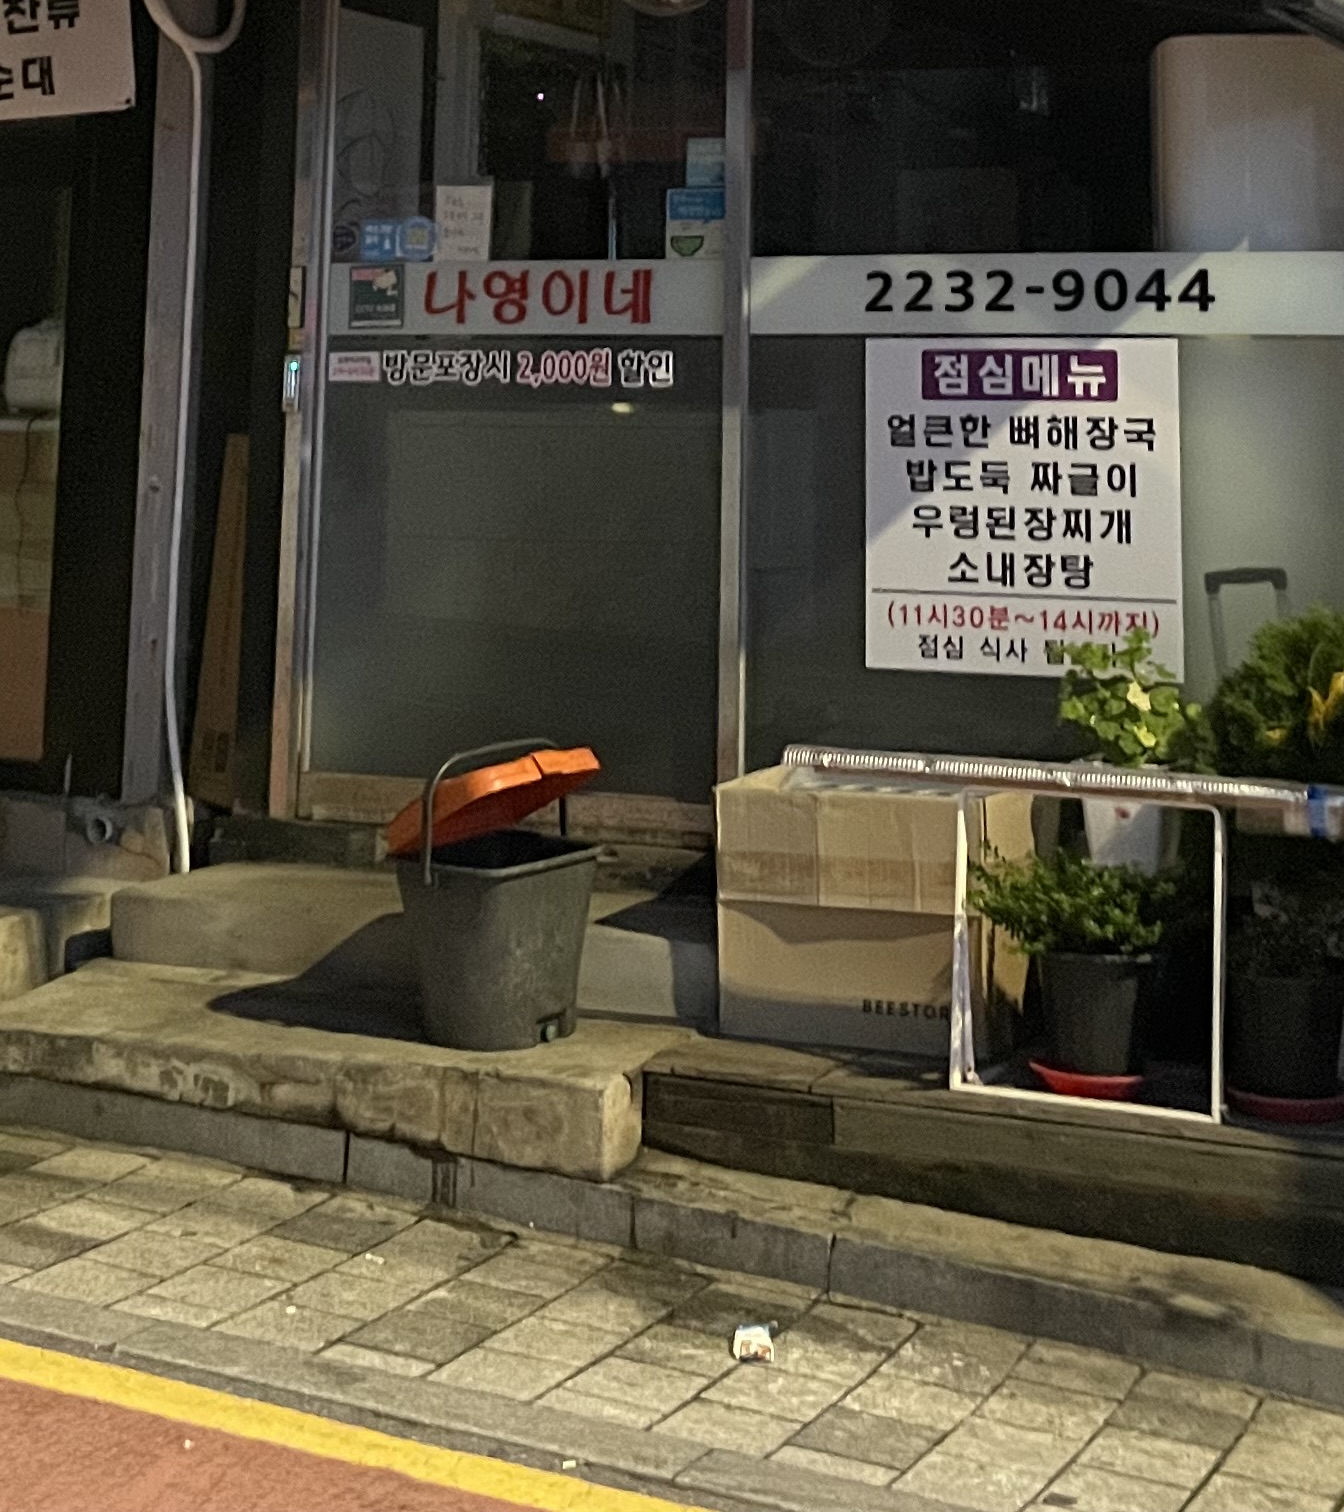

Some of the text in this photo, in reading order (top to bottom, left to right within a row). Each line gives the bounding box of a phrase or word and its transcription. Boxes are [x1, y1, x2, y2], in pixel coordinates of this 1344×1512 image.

[423, 268, 653, 326] 나영이네
[863, 268, 1216, 313] 2232-9044
[384, 350, 510, 385] 방문포장시
[516, 348, 613, 386] 2,000원
[618, 351, 674, 387] 할인
[933, 354, 1107, 397] 점심메뉴
[887, 413, 1156, 451] 얼큰한 뼈해장국
[906, 459, 1137, 498] 밥도둑 짜글이
[911, 505, 1133, 544] 우렁된장찌개
[947, 552, 1093, 589] 소내장탕
[918, 634, 964, 660] 점심
[980, 636, 1027, 663] 식사
